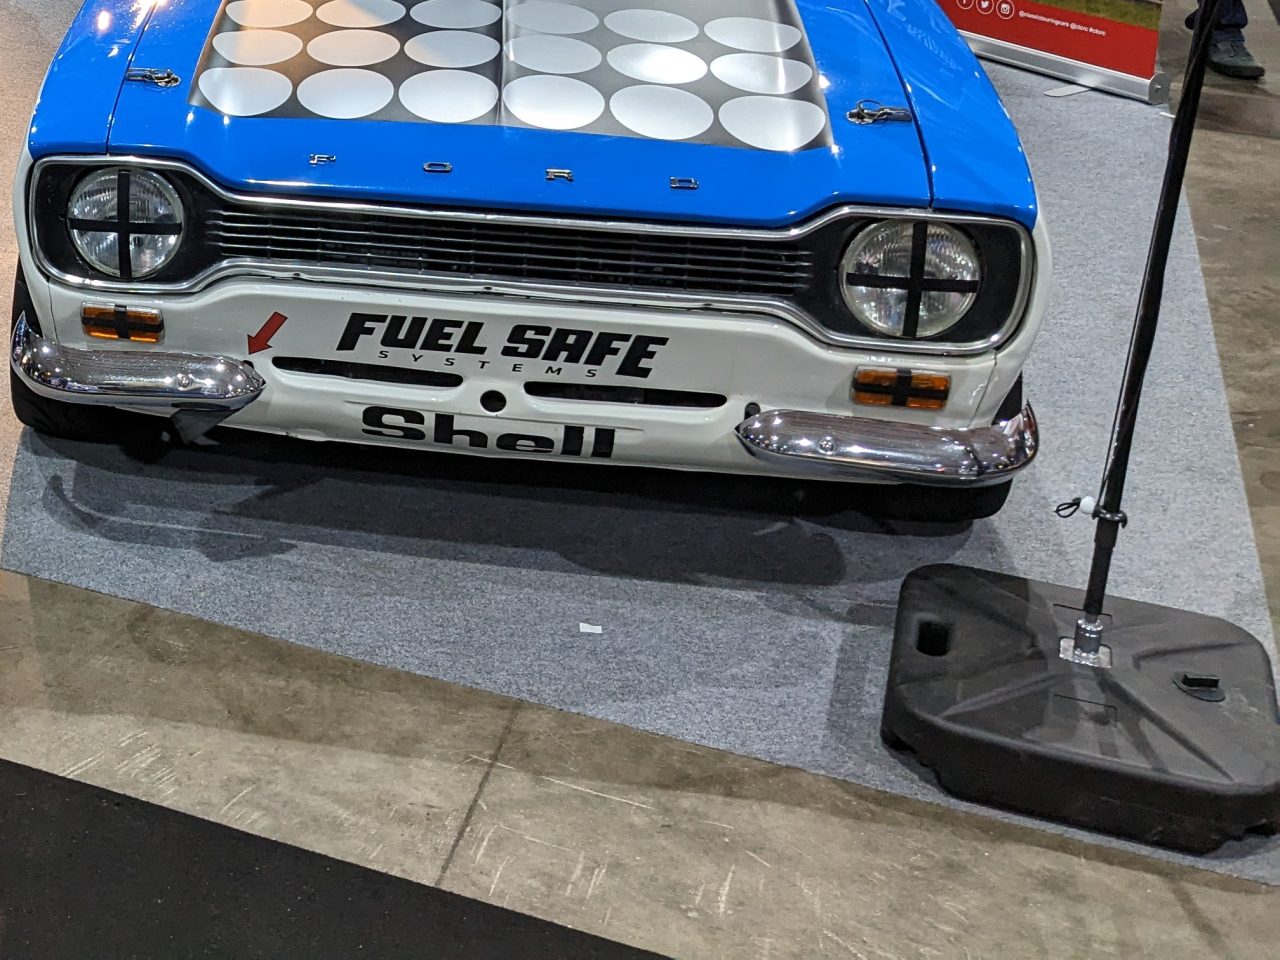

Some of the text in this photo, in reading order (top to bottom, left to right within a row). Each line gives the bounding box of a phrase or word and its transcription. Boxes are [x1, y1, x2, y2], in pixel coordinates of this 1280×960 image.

[309, 152, 700, 191] FORD
[336, 312, 670, 379] FUEL SAFE
[377, 349, 599, 379] SYSTEMS
[361, 404, 617, 460] Shell
